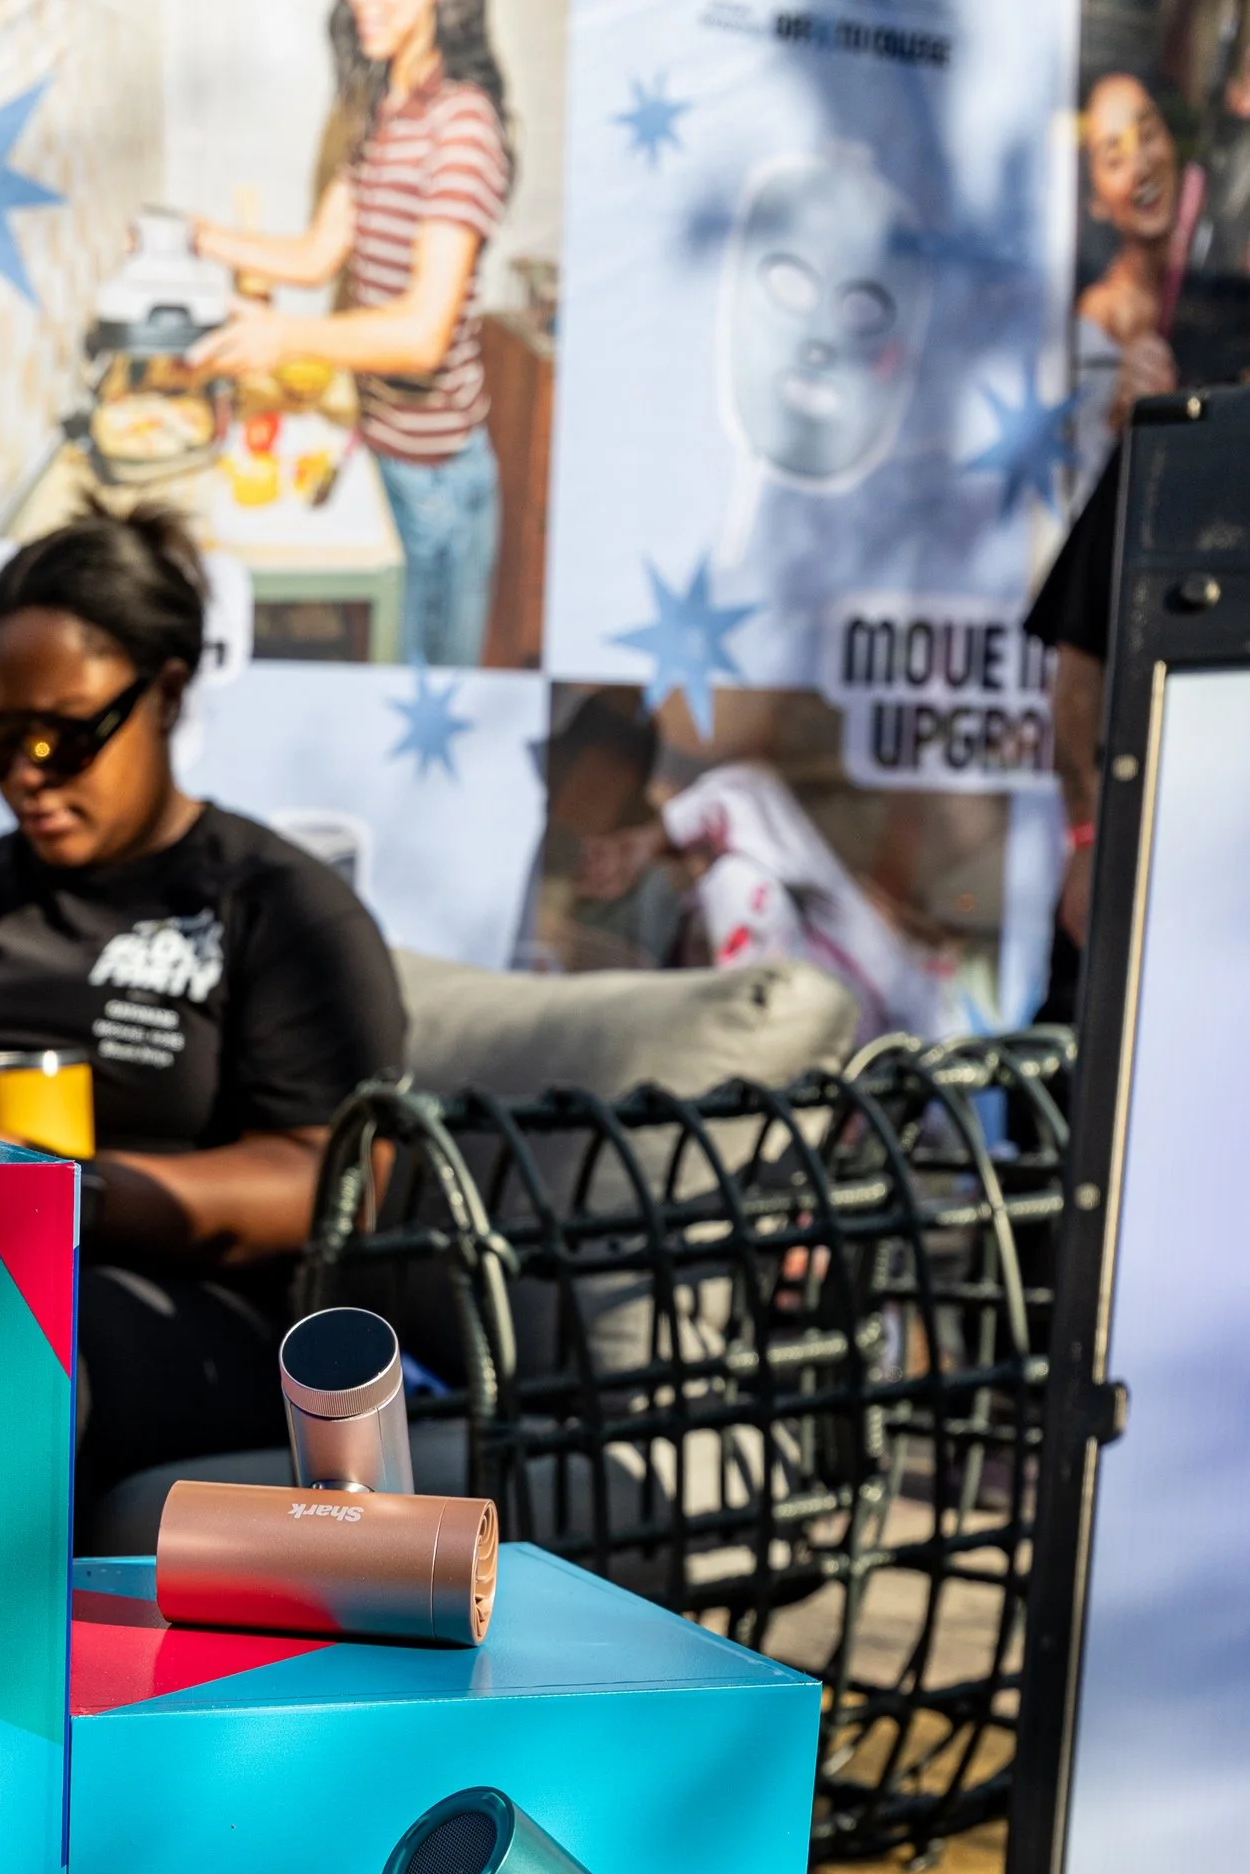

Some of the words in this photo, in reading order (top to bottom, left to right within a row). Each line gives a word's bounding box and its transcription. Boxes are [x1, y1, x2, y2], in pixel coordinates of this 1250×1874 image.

[845, 618, 1005, 690] MOVE
[872, 704, 1046, 772] UPGRA
[287, 1503, 364, 1522] Shark
